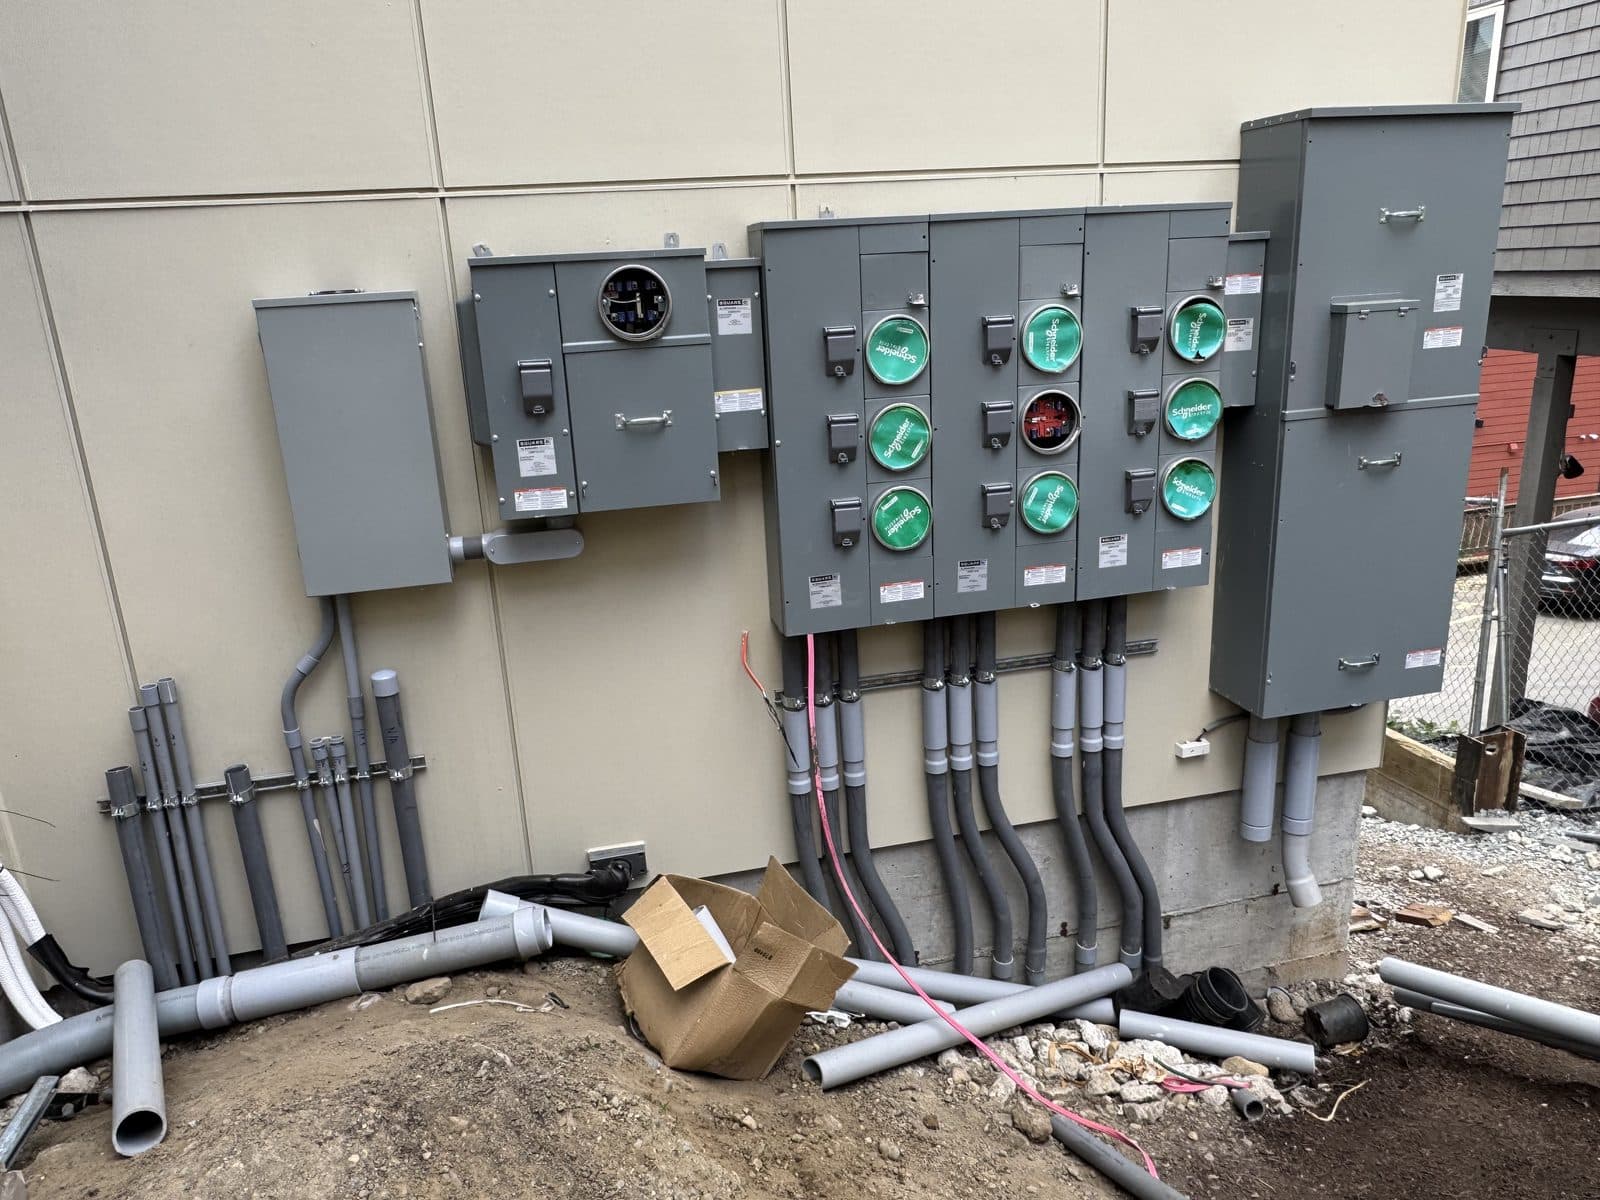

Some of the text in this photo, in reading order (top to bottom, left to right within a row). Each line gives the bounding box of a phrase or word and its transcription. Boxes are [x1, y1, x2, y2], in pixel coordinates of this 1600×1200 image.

[876, 344, 918, 364] Schneider
[1045, 318, 1060, 362] Schneider
[1172, 403, 1212, 419] Schneider
[883, 418, 910, 458] Schneider
[1172, 477, 1206, 497] Schneider
[1041, 485, 1064, 524] Schneider
[887, 505, 921, 537] Schneider
